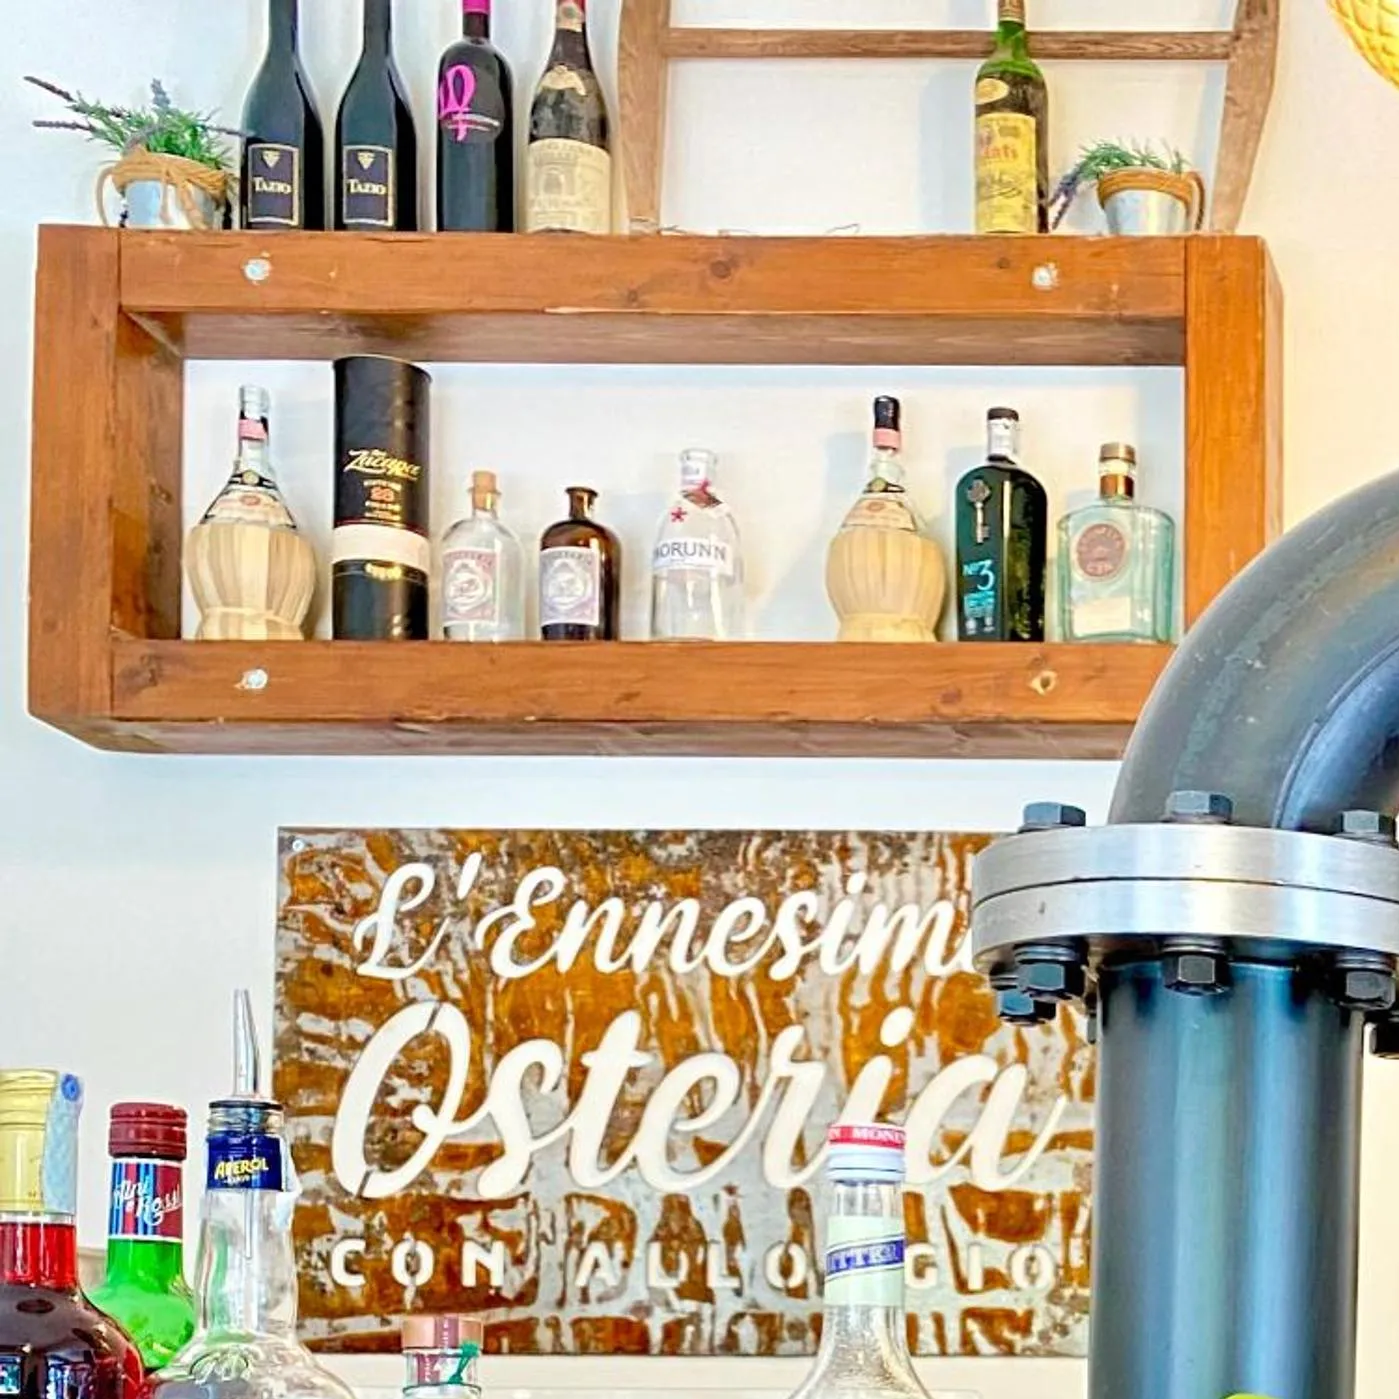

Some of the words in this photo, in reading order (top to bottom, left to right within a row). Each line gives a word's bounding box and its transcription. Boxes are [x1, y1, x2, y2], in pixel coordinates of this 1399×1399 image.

[354, 853, 974, 981] L'Ennesim
[331, 1000, 1068, 1202] Osteria
[330, 1237, 507, 1290] CON
[575, 1239, 1058, 1291] ALLOGIO
